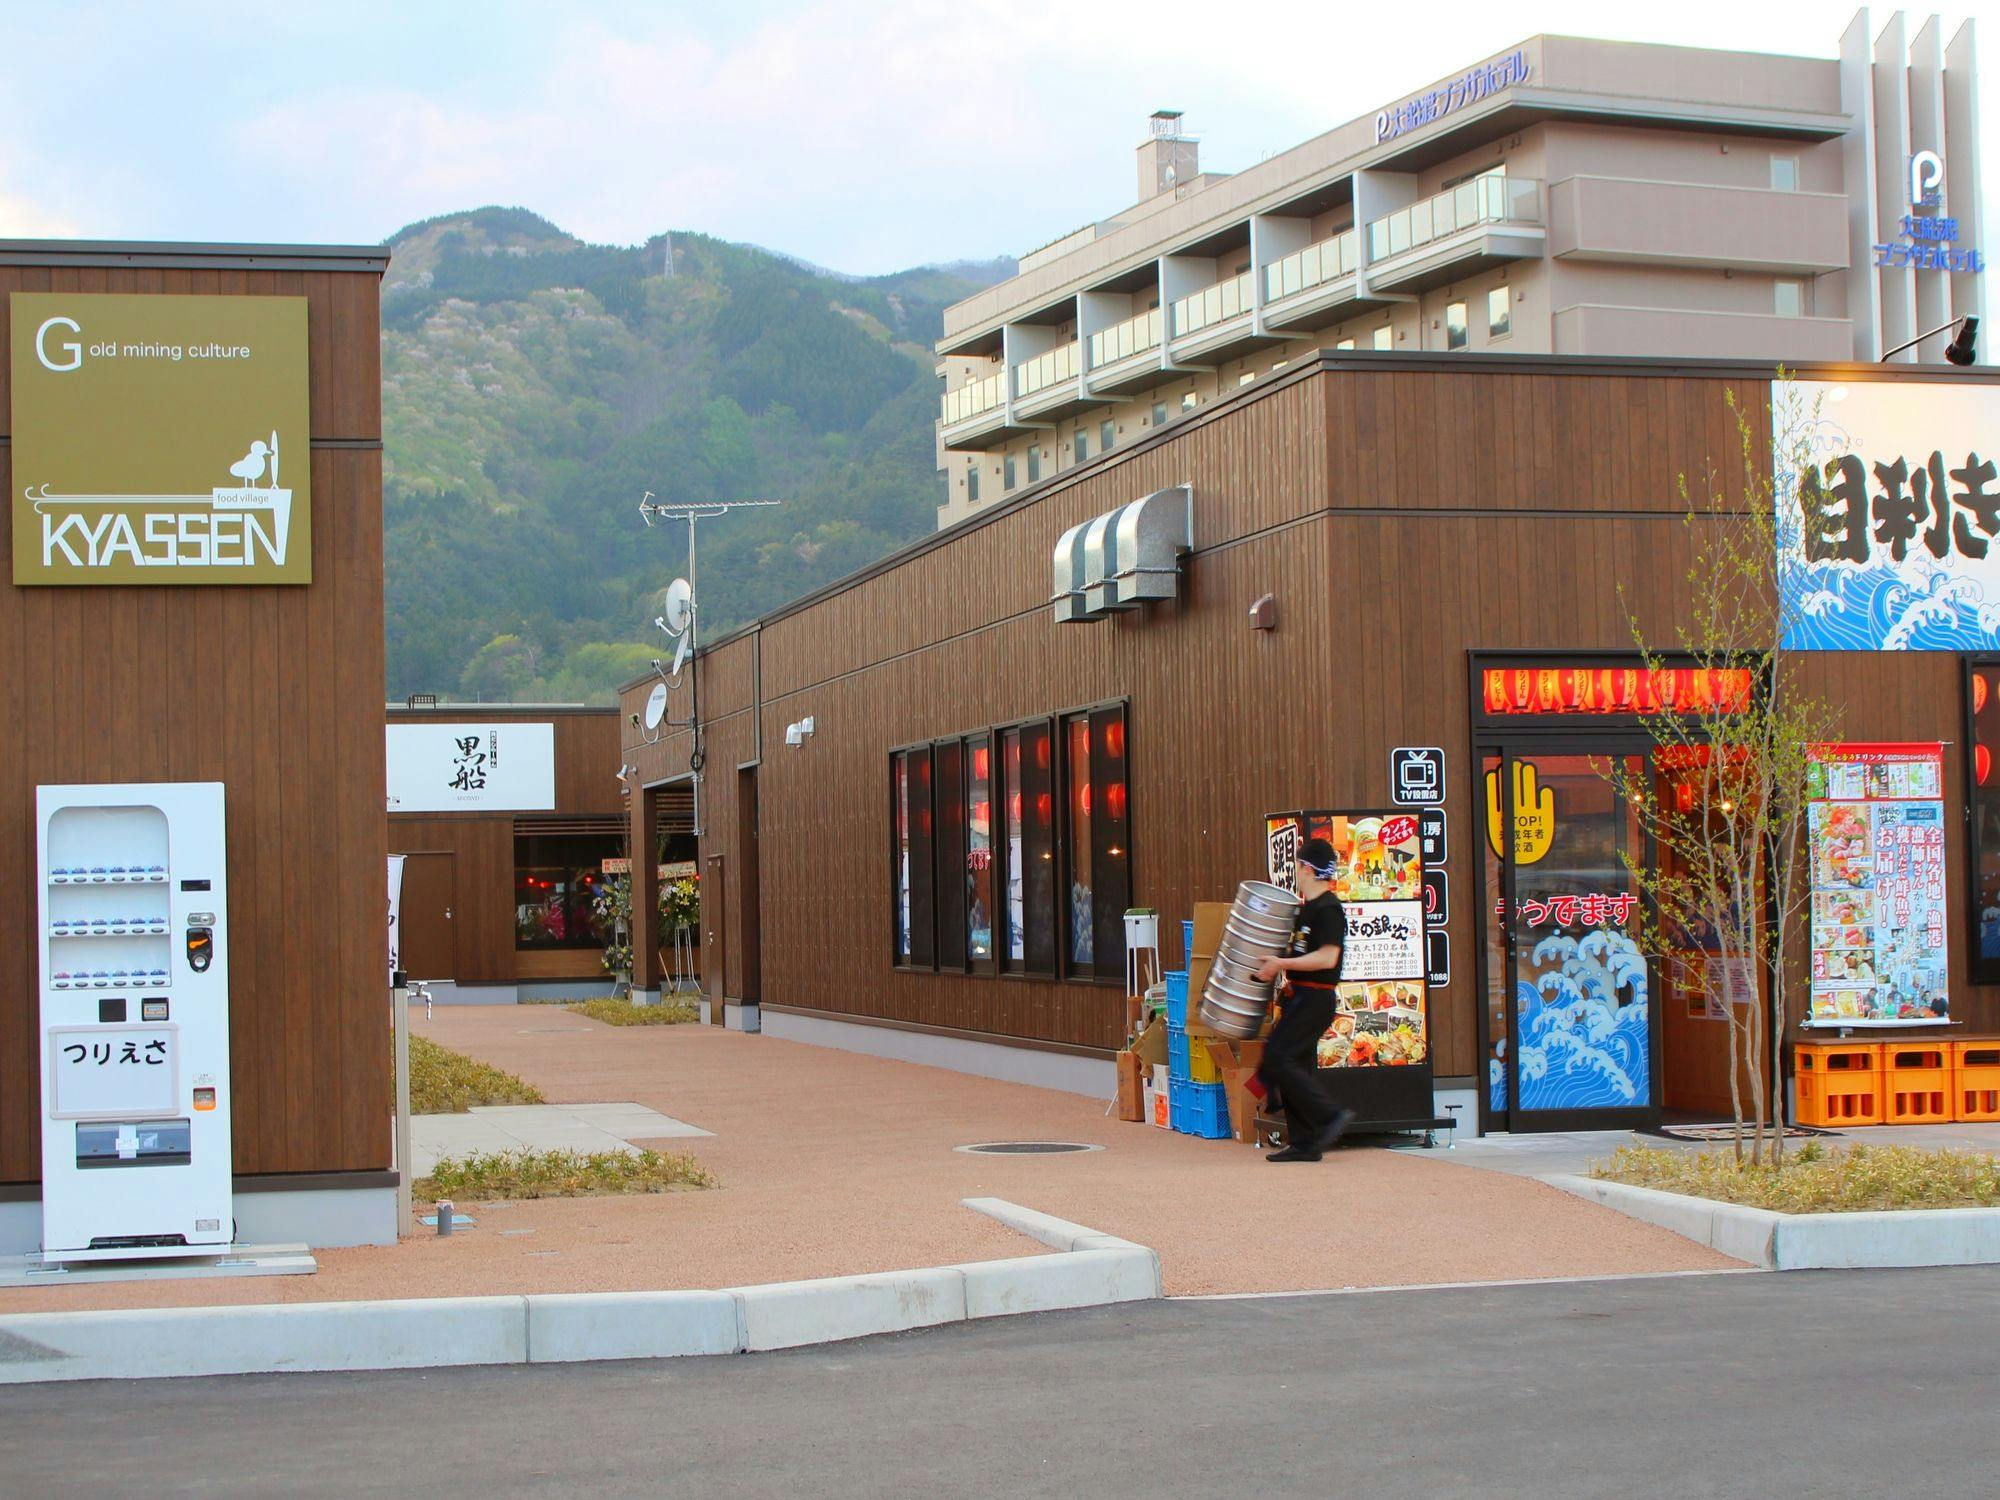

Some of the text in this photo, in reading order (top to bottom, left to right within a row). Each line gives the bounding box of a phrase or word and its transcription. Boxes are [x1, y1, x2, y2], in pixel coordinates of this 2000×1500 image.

[1873, 242, 1986, 273] プラザホテル
[123, 342, 182, 361] mining
[188, 342, 250, 358] culture
[217, 493, 269, 507] food village
[43, 513, 287, 566] KYASSEN
[448, 736, 487, 791] 黒船
[1400, 789, 1438, 800] TV設置店
[1382, 818, 1409, 837] ランチ
[1383, 827, 1413, 846] やってます
[1874, 826, 1896, 929] お届け！
[1515, 892, 1638, 928] ってます
[63, 1039, 166, 1066] つりえさ
